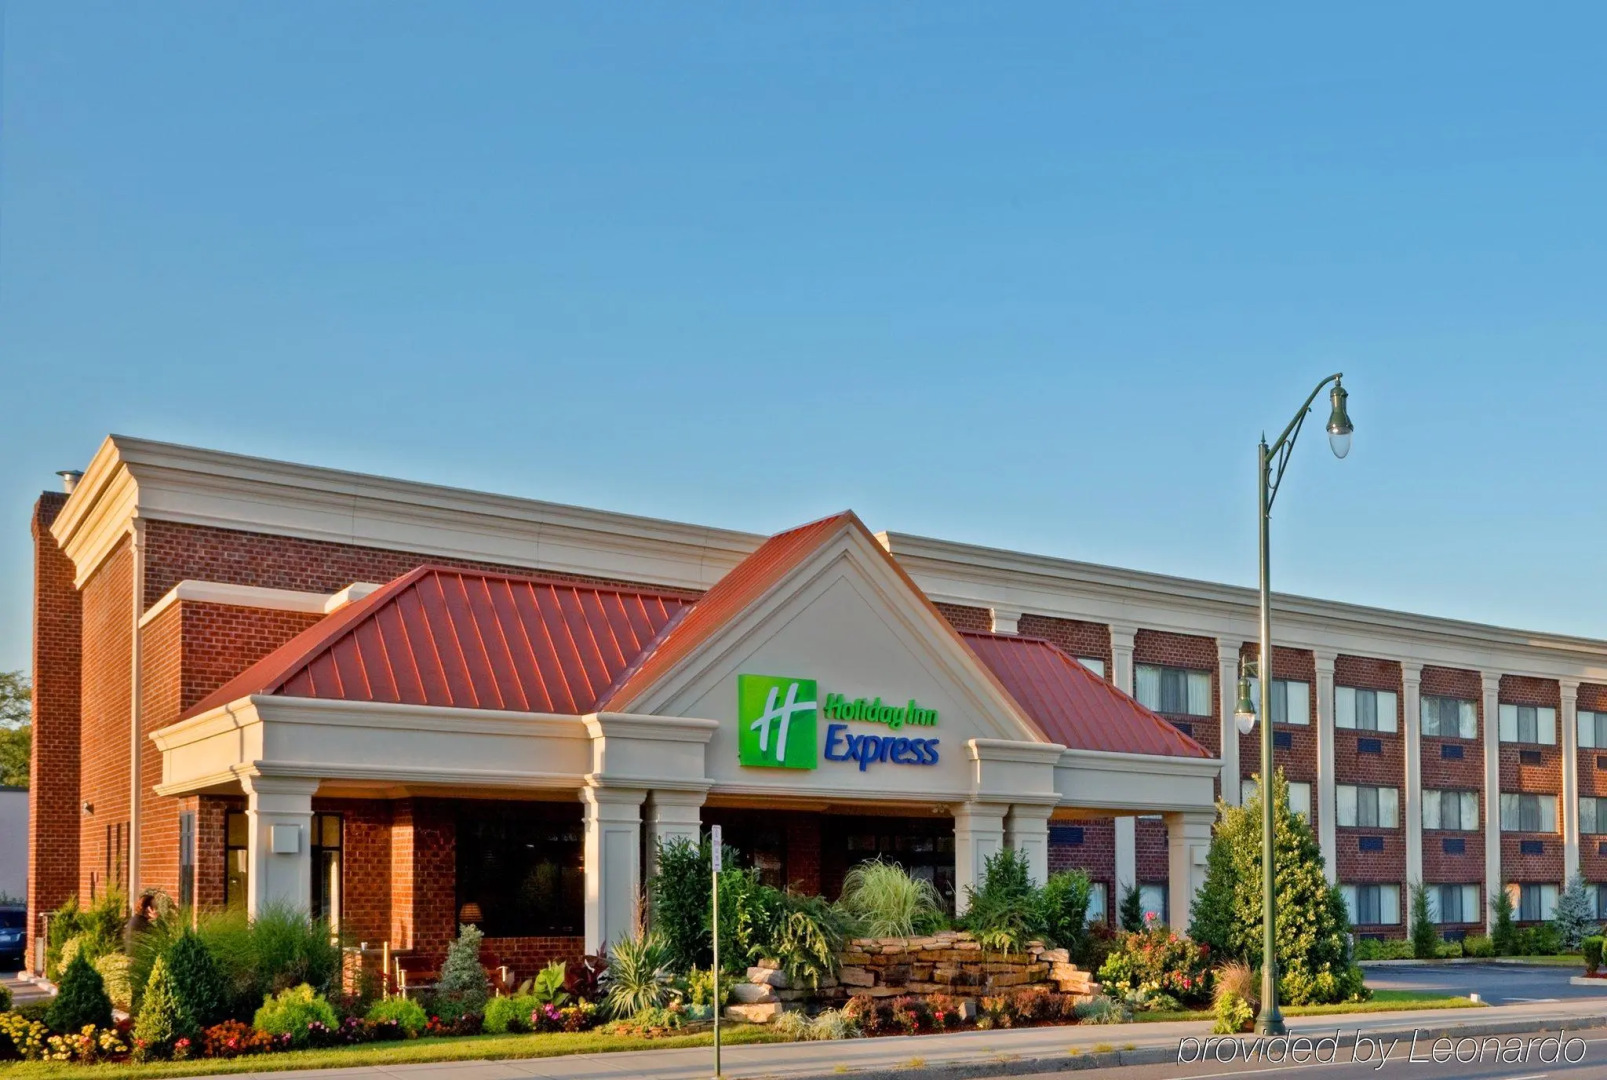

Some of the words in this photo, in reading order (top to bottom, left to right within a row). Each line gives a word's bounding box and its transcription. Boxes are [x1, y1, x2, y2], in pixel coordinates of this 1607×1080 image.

[824, 693, 904, 730] Holiday
[906, 699, 939, 726] Inn
[824, 724, 939, 772] Express
